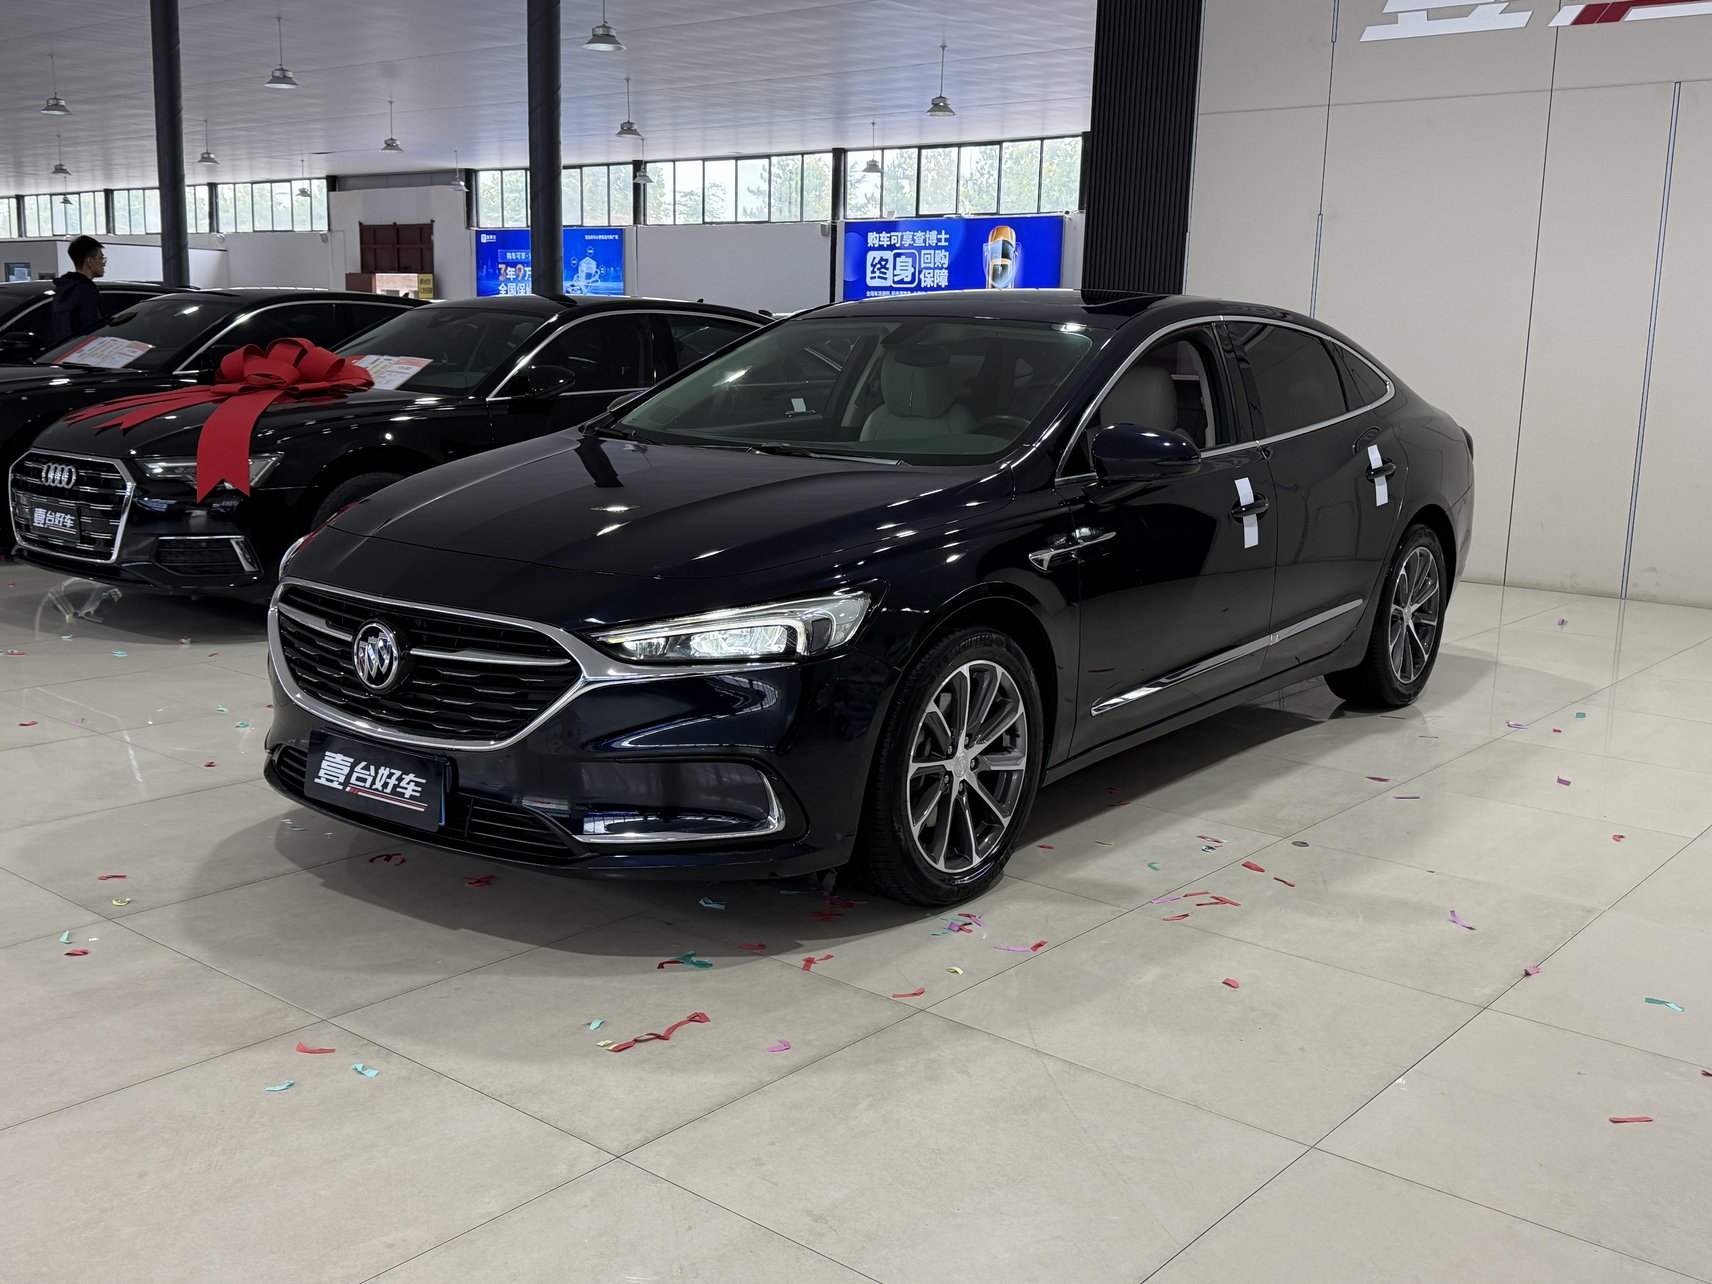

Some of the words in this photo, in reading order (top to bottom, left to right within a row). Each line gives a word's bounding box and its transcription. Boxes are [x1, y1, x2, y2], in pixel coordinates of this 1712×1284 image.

[867, 230, 950, 247] 购车可享查博士
[869, 255, 915, 282] 终身
[921, 249, 949, 268] 回购
[920, 269, 949, 288] 保障
[33, 507, 75, 528] 壹台好车
[314, 751, 427, 799] 壹台好车
